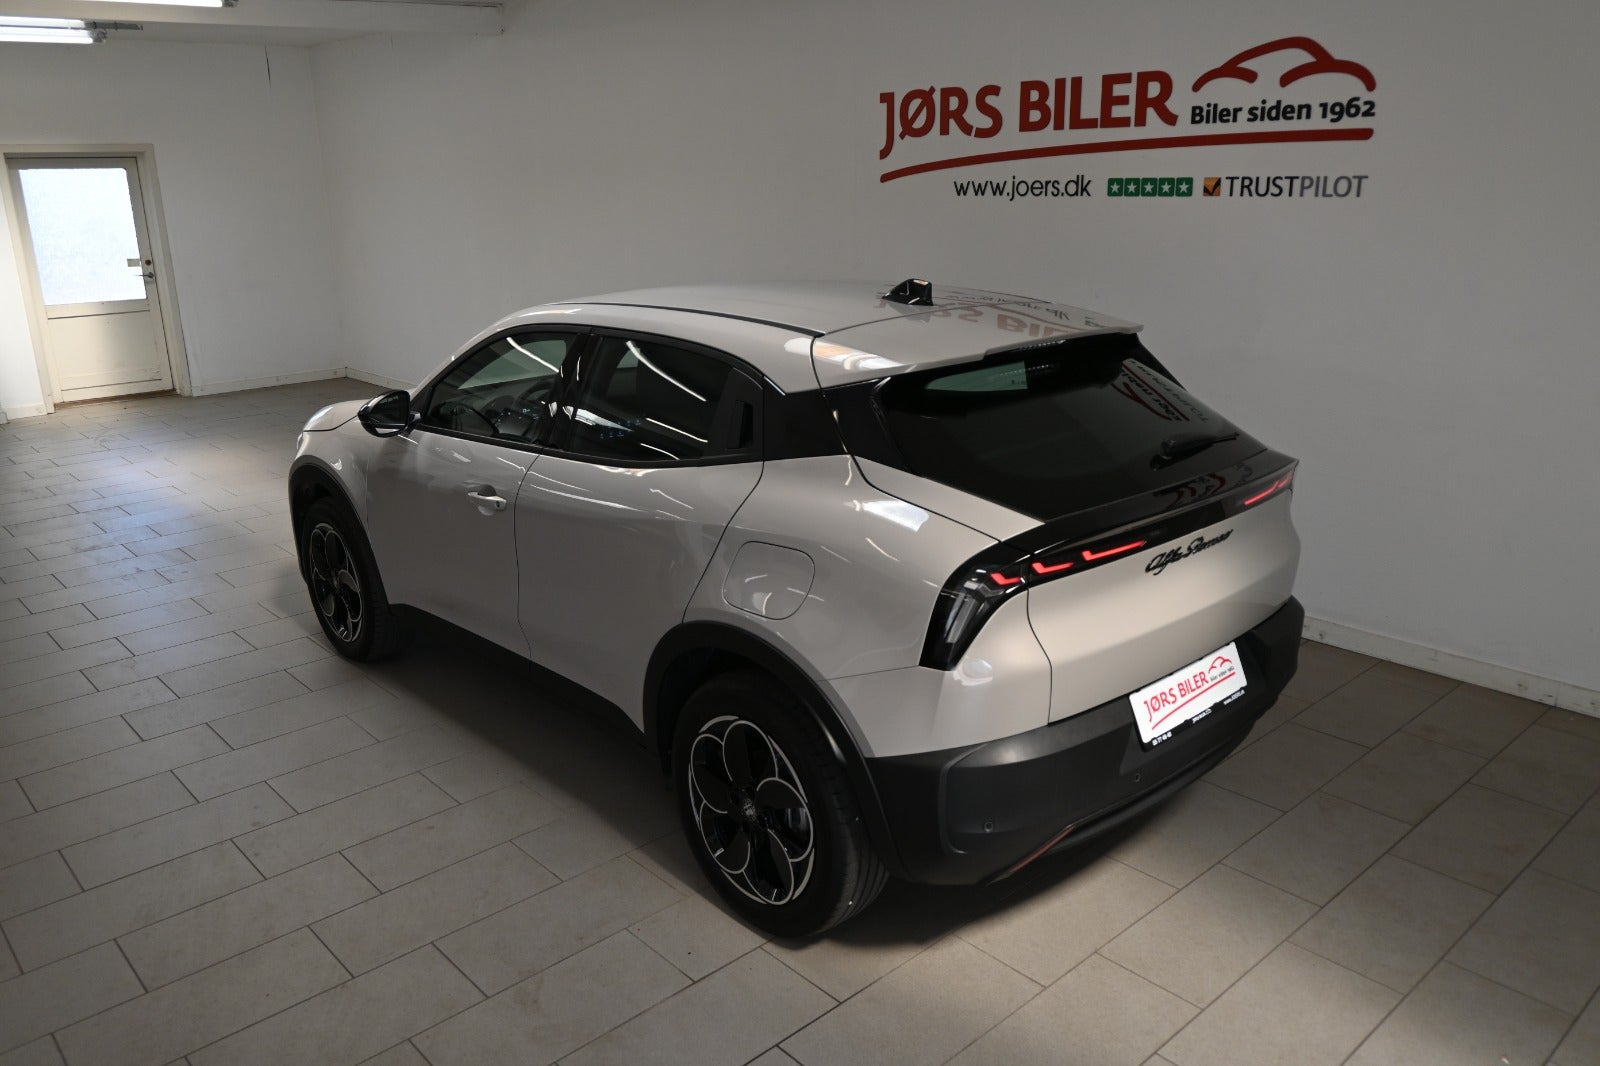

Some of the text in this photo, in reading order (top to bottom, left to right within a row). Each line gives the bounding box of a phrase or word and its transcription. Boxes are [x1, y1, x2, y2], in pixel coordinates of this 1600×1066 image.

[880, 70, 1180, 161] JØRS BILER
[1190, 97, 1376, 125] Biler siden 1962
[953, 174, 1092, 202] www.joers.dk
[1226, 175, 1369, 198] TRUSTPILOT
[1143, 687, 1178, 722] JØRS
[1177, 671, 1209, 698] BILER
